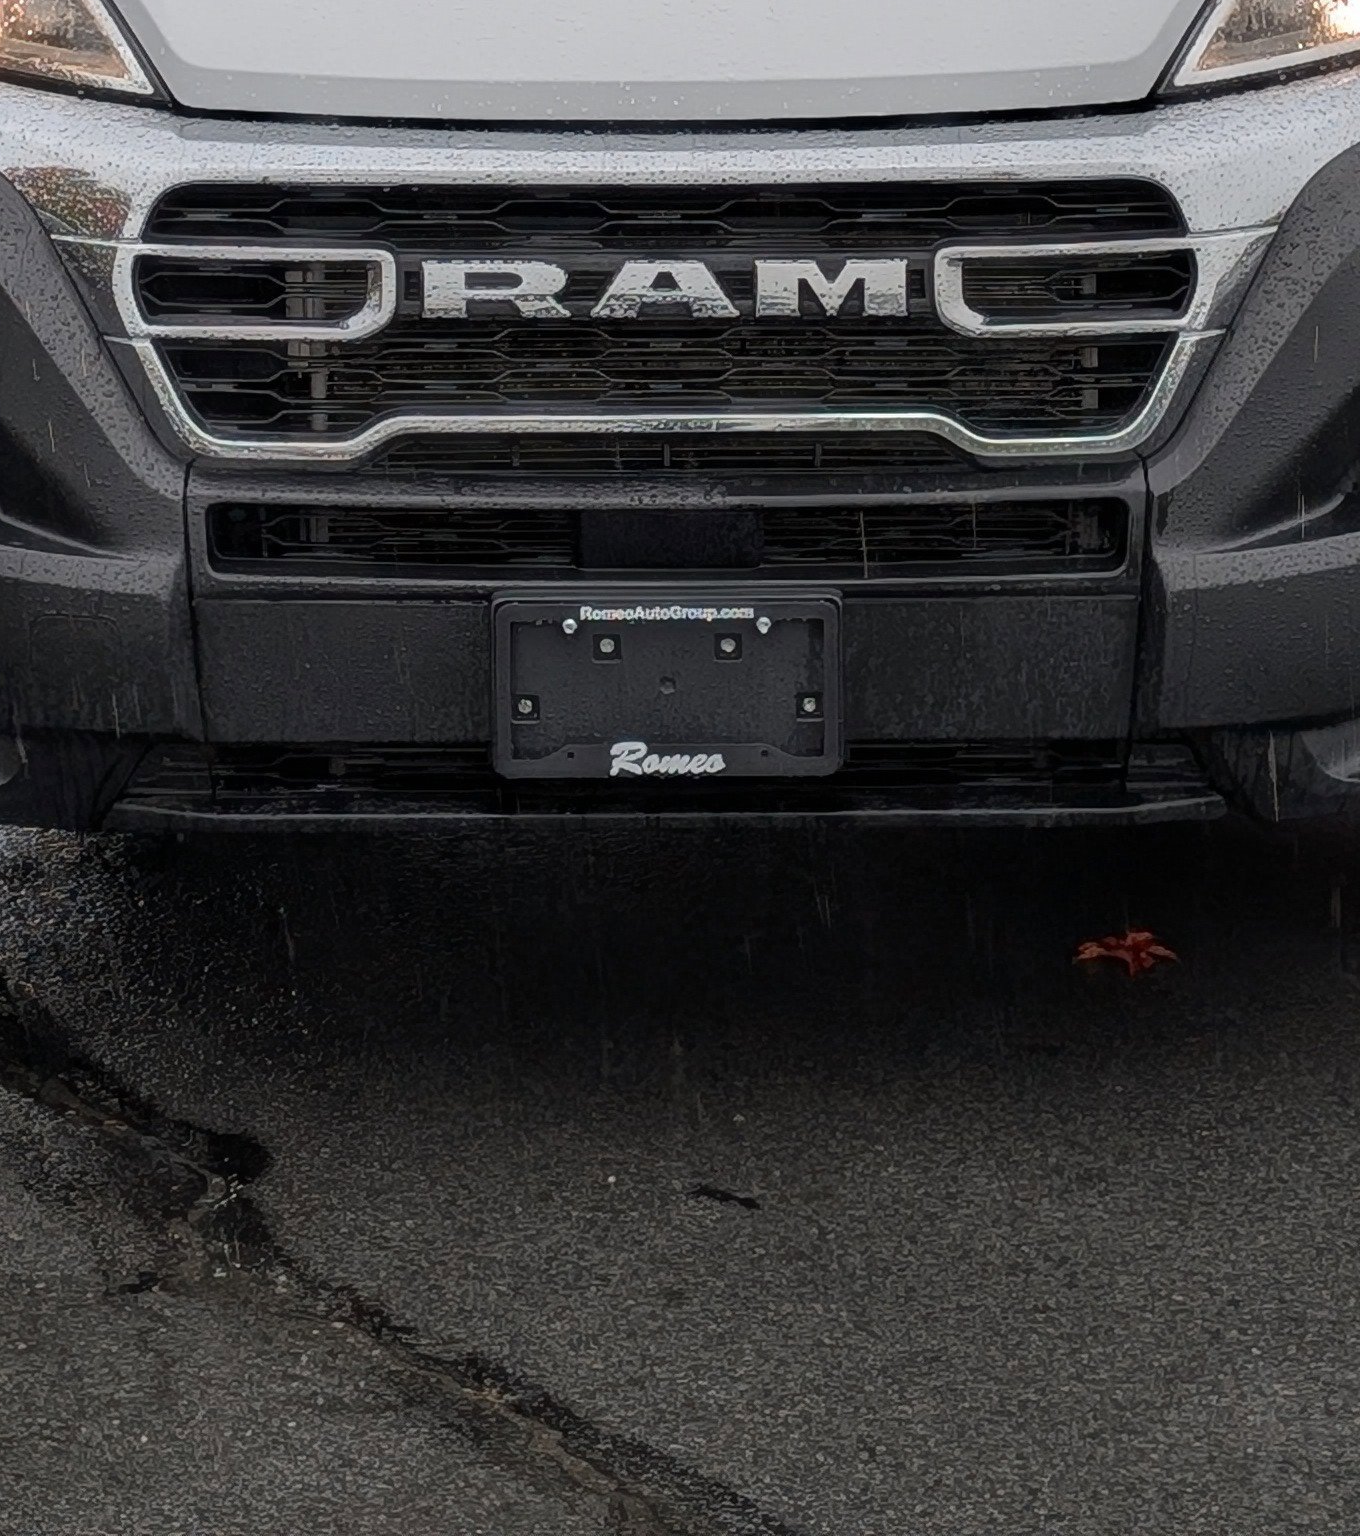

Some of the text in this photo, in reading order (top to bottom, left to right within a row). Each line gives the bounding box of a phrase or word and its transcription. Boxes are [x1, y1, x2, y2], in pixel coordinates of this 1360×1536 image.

[420, 258, 909, 320] RAM
[579, 605, 755, 622] RomeoAutoGroup.com
[608, 740, 726, 777] Romeo
